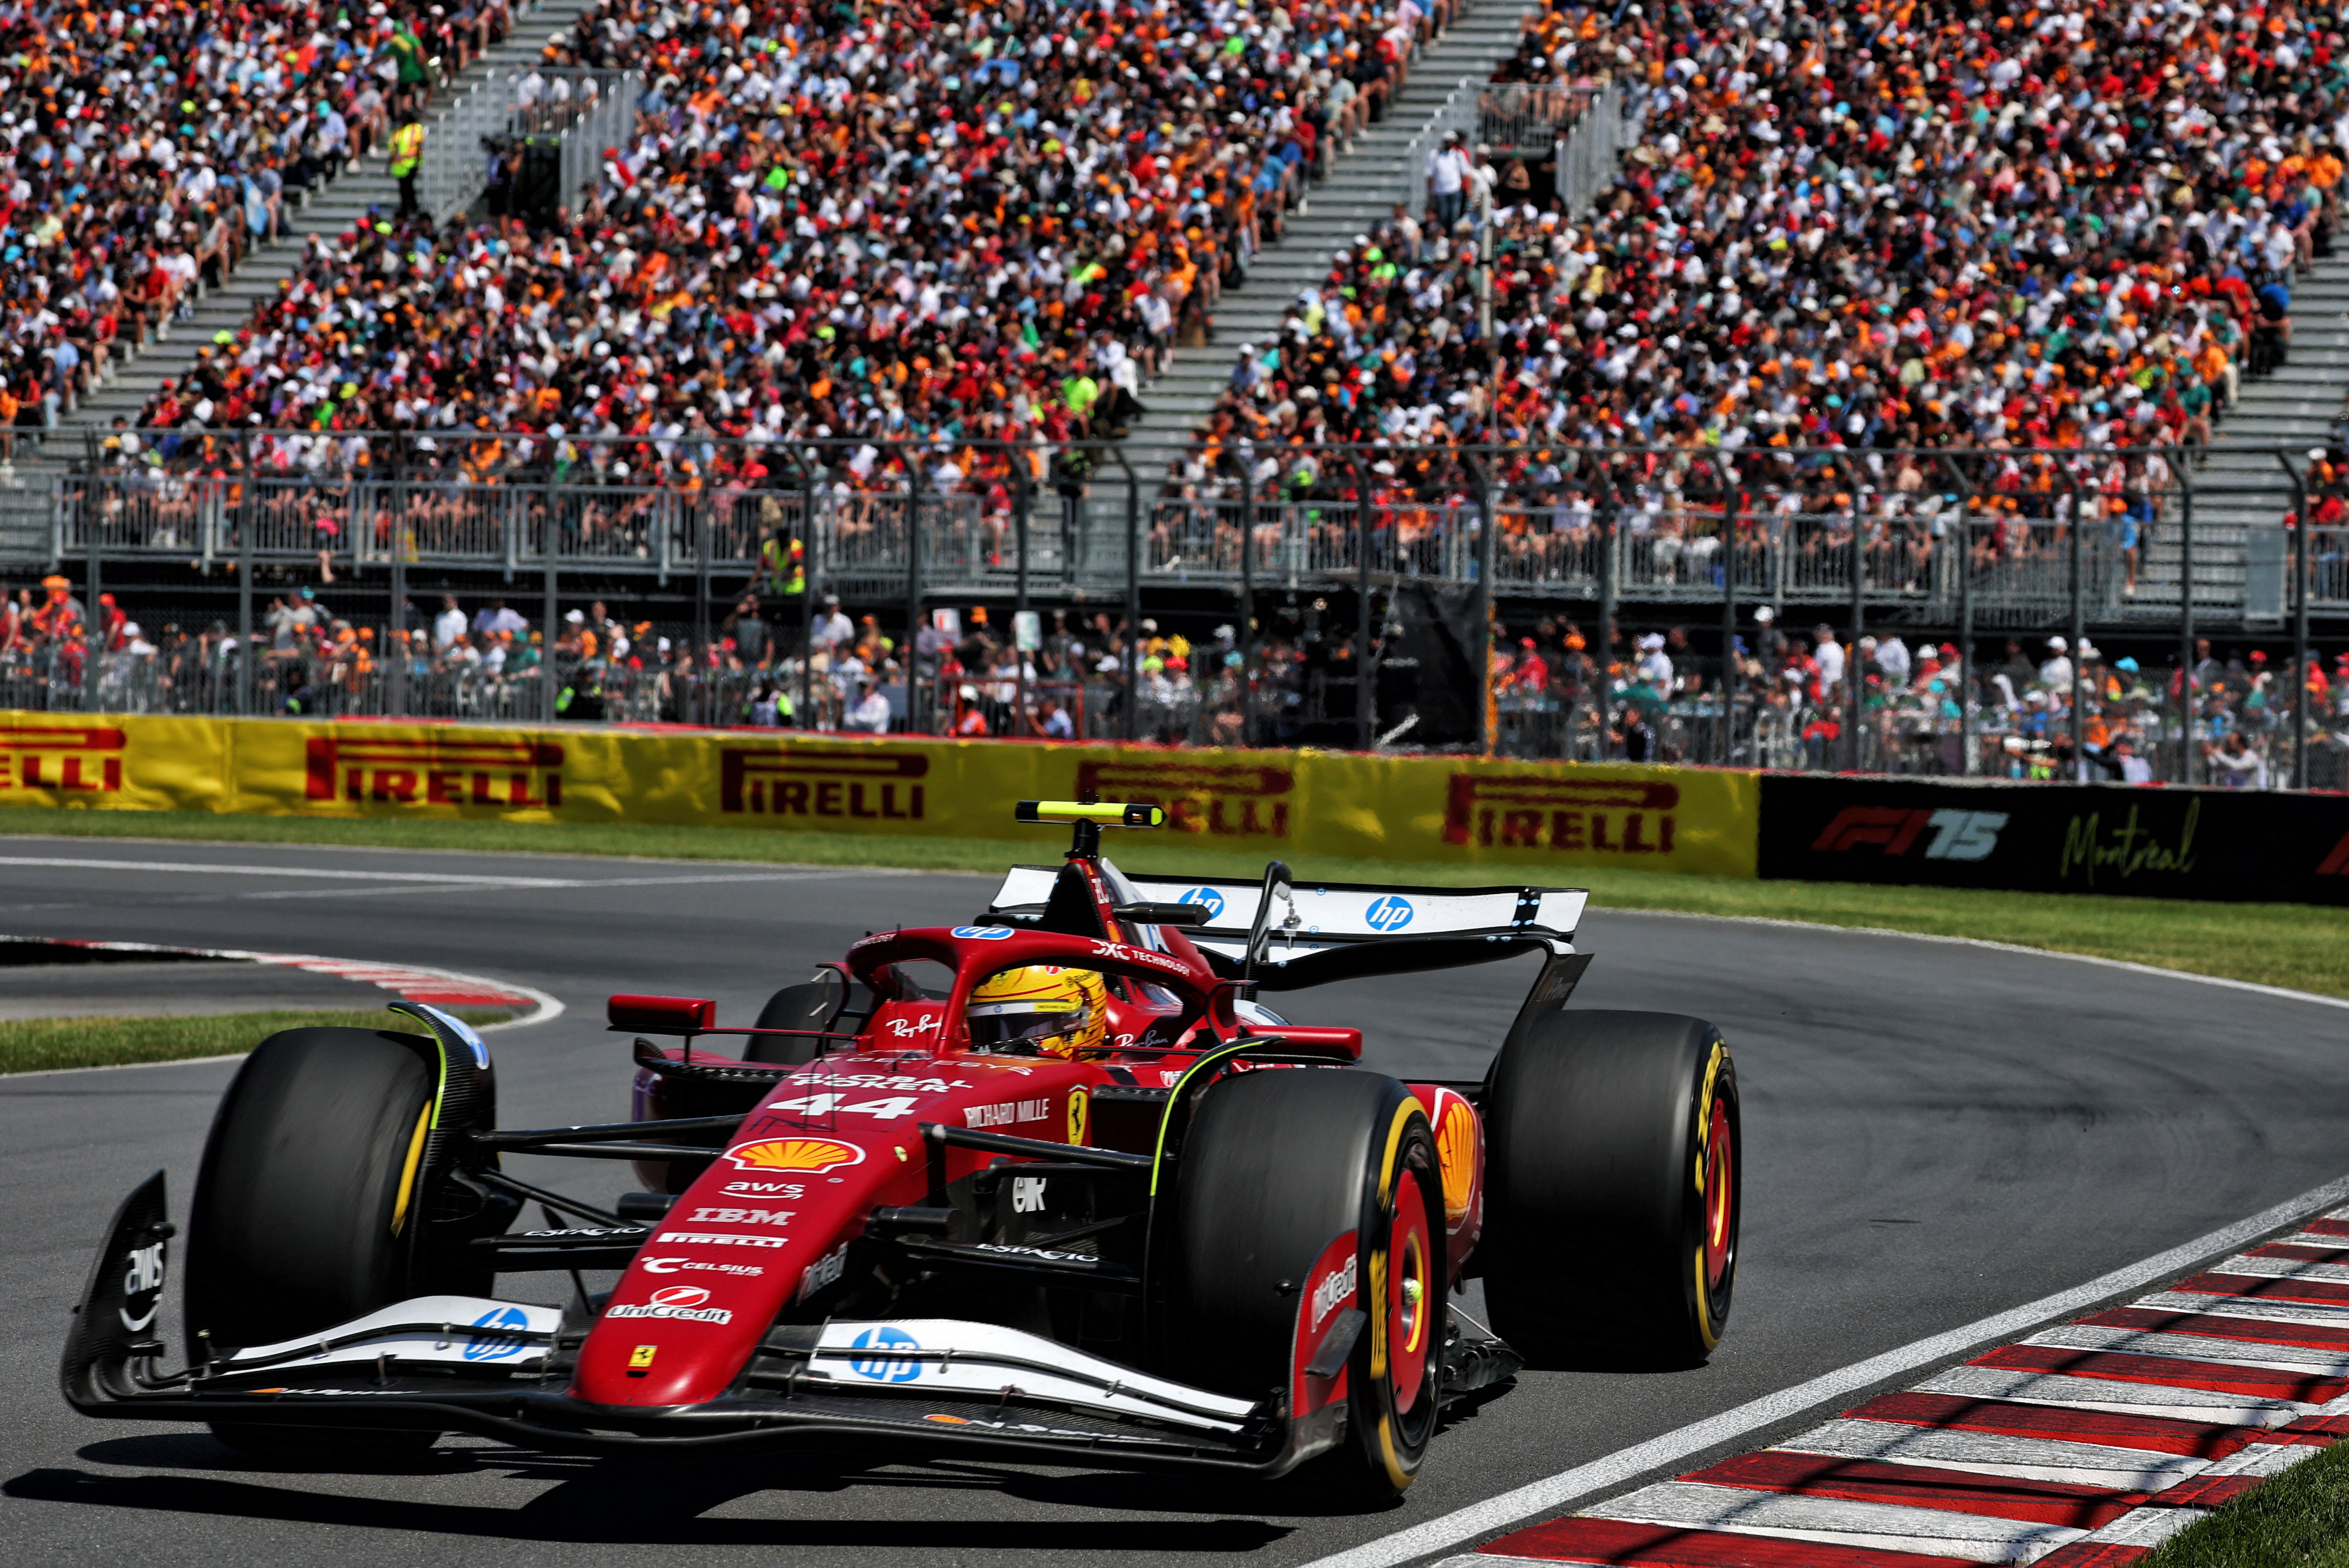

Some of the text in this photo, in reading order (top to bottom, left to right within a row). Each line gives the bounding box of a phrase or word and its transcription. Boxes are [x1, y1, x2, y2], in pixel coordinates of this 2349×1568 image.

[306, 736, 564, 807] PIRELLI
[720, 748, 929, 820] PIRELLI
[1074, 760, 1295, 837] PELLI
[1442, 774, 1679, 854] PIRELLI
[1368, 896, 1411, 932] hp
[1090, 939, 1190, 977] DXC TECHNOLOGY
[845, 1056, 1034, 1076] GEESYS
[788, 1073, 974, 1089] GLOBAL
[792, 1079, 950, 1093] POKER
[769, 1093, 920, 1119] 44
[963, 1098, 1050, 1129] RICHARD MILLE
[724, 1181, 806, 1194] aws
[686, 1207, 797, 1226] IBM
[656, 1232, 789, 1248] PIRELLI
[975, 1243, 1100, 1262] ESPACIO
[681, 1262, 764, 1274] CELSIUS
[605, 1305, 733, 1325] UniCredit
[858, 1327, 917, 1382] hp
